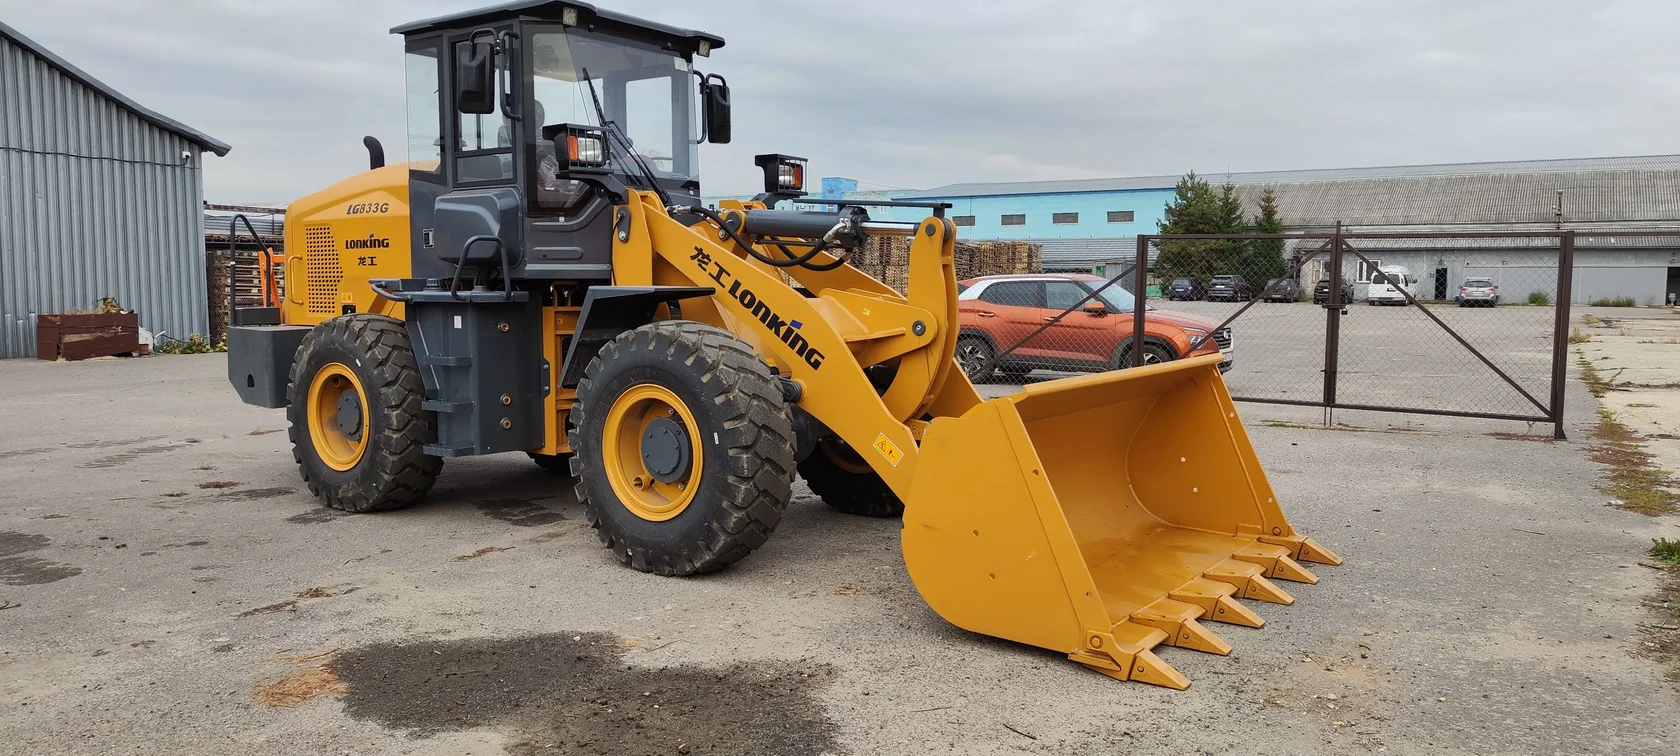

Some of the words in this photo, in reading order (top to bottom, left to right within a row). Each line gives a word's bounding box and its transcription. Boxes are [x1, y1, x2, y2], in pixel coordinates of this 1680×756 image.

[346, 203, 389, 215] LG833G
[357, 256, 378, 267] 龙工
[690, 246, 731, 288] 龙工
